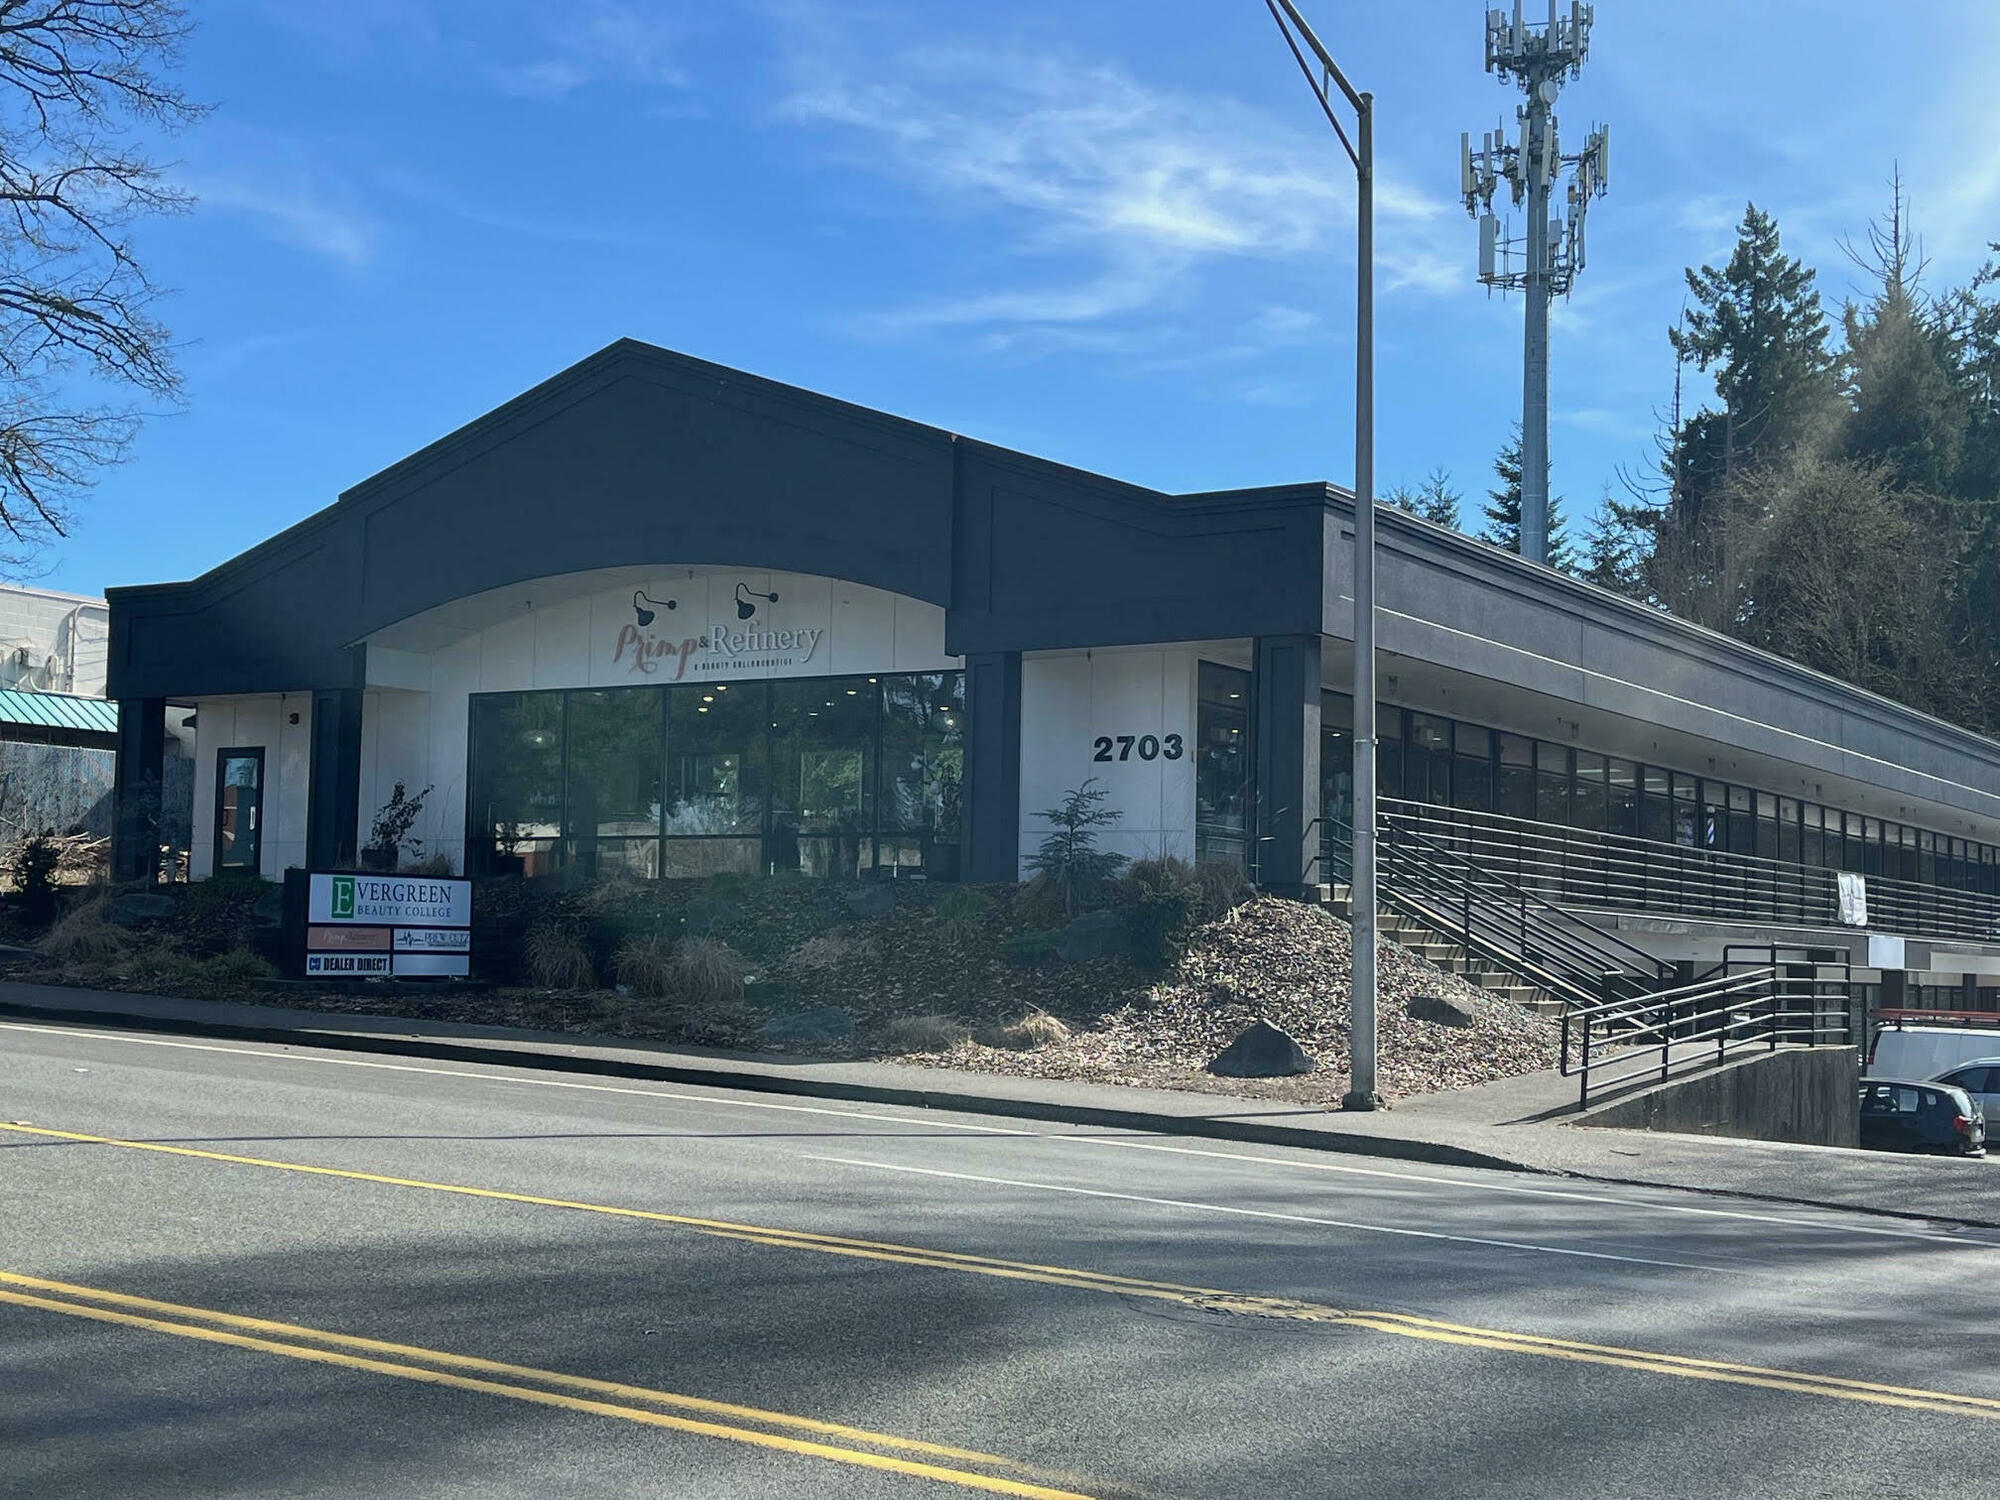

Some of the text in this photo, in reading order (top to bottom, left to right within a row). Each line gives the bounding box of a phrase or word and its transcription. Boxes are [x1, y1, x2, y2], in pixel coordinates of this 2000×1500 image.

[613, 619, 823, 680] Primp & Refinery
[702, 661, 729, 670] BEAUTY
[1093, 733, 1184, 762] 2703
[333, 881, 453, 914] EVERGREEN
[357, 904, 451, 918] BEAUTY COLLEGE
[308, 957, 387, 971] CU DEALER DIRECT
